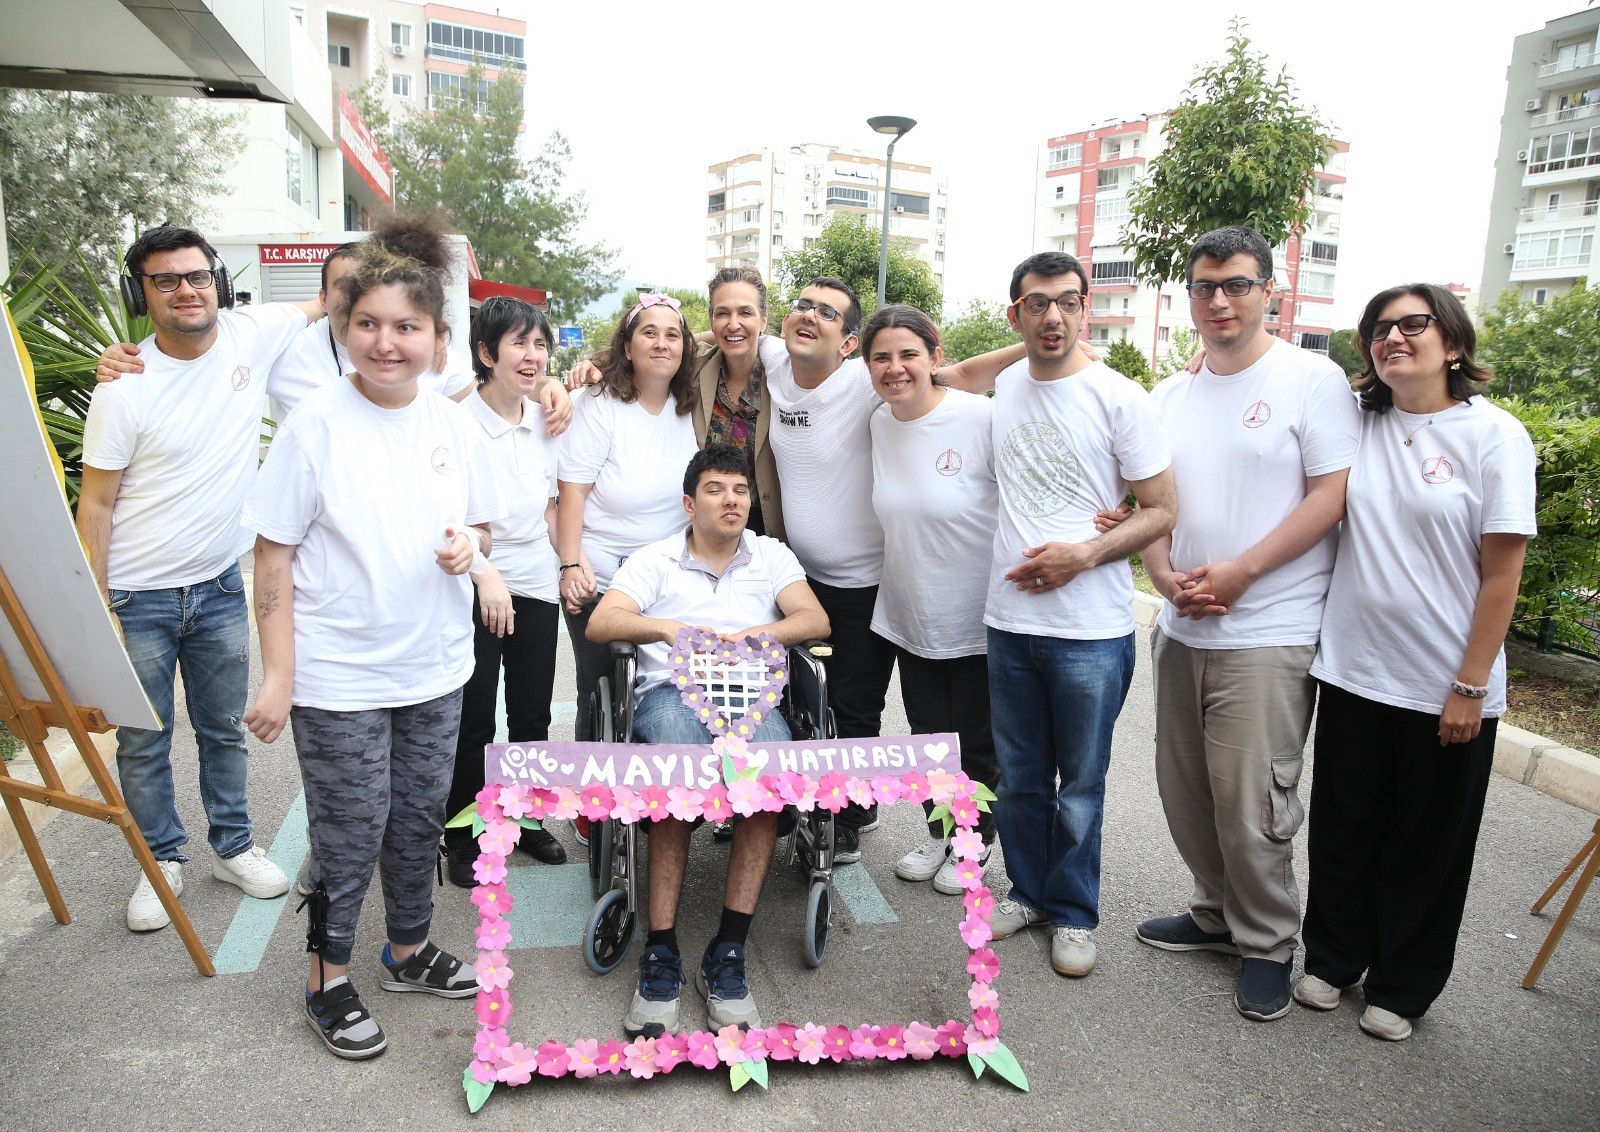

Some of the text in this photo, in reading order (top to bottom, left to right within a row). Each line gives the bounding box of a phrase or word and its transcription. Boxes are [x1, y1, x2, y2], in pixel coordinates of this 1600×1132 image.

[263, 248, 282, 260] T.C.
[797, 416, 811, 427] ME.
[580, 754, 720, 790] MAYIS
[778, 744, 917, 772] HATIRASI
